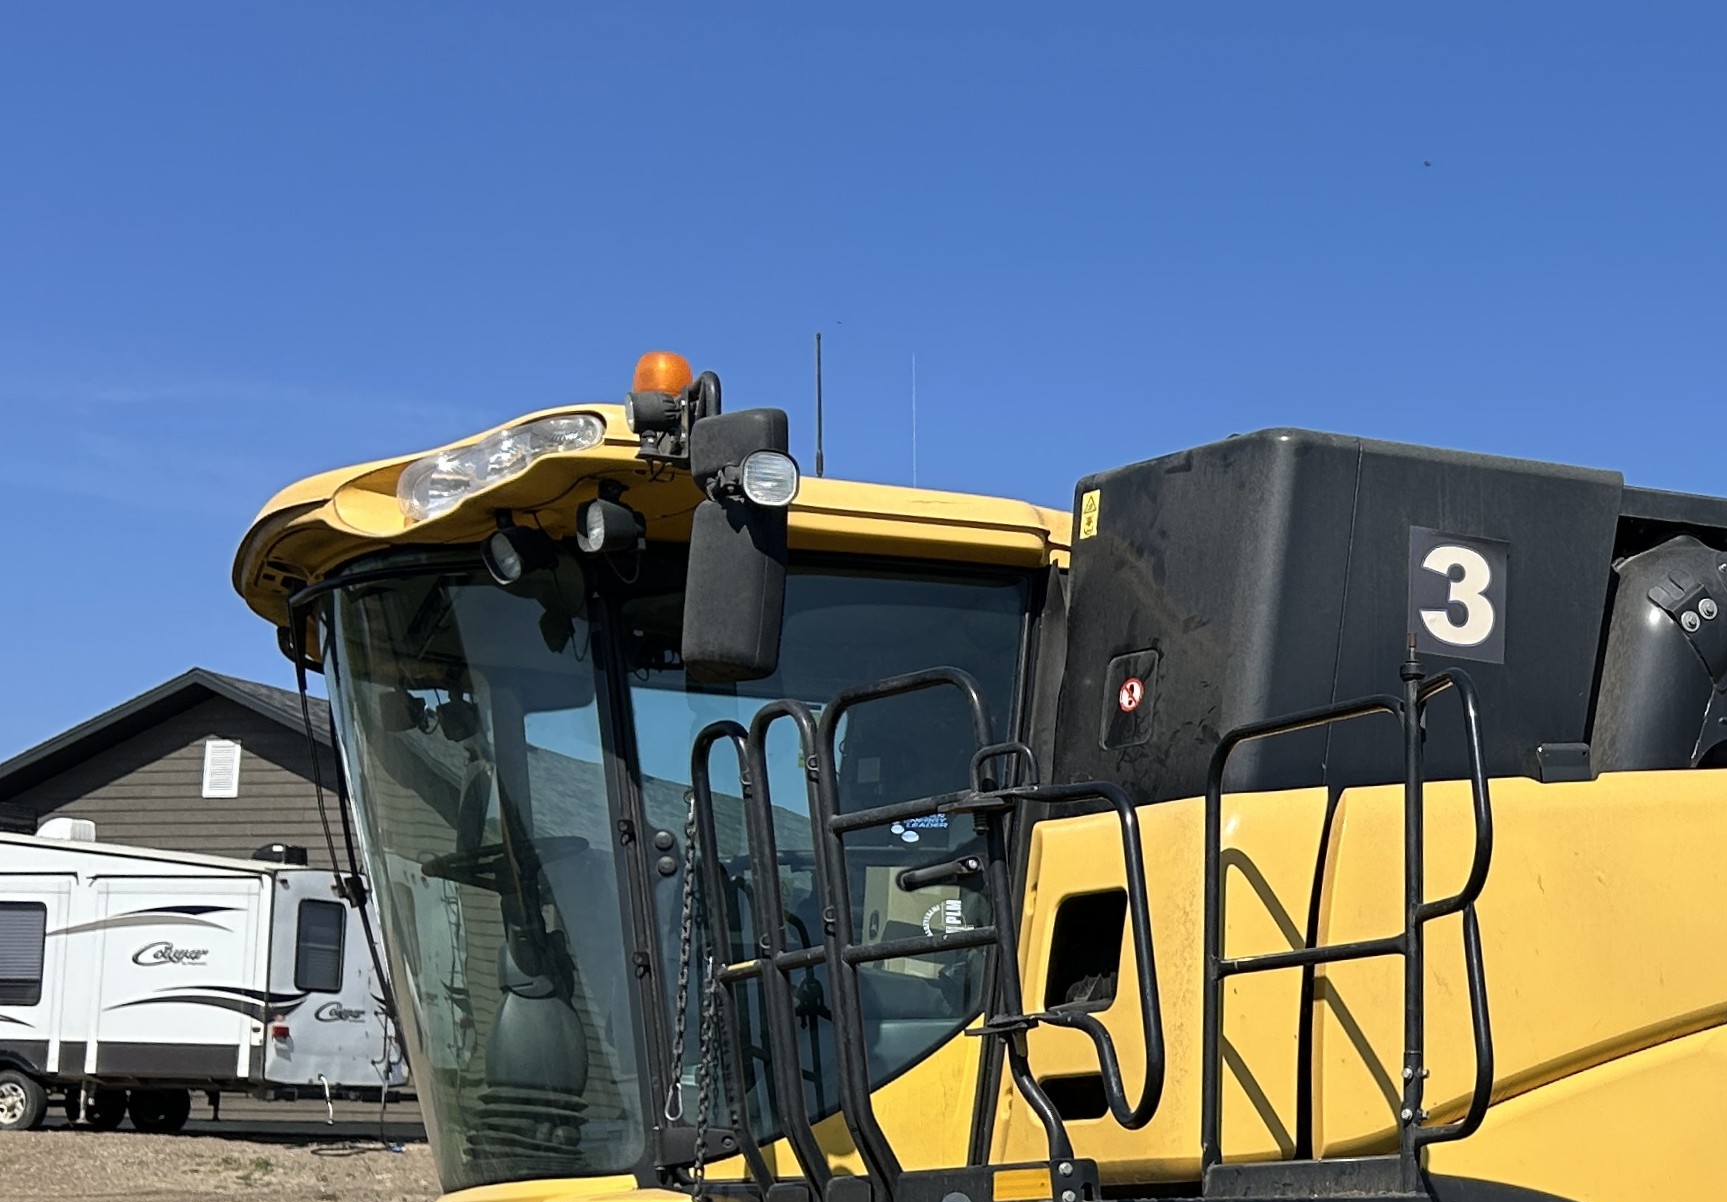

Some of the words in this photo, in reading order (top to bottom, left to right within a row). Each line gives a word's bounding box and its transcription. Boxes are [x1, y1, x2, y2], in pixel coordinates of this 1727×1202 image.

[1419, 545, 1495, 646] 3
[945, 899, 962, 925] PLM
[132, 941, 209, 967] Cougar
